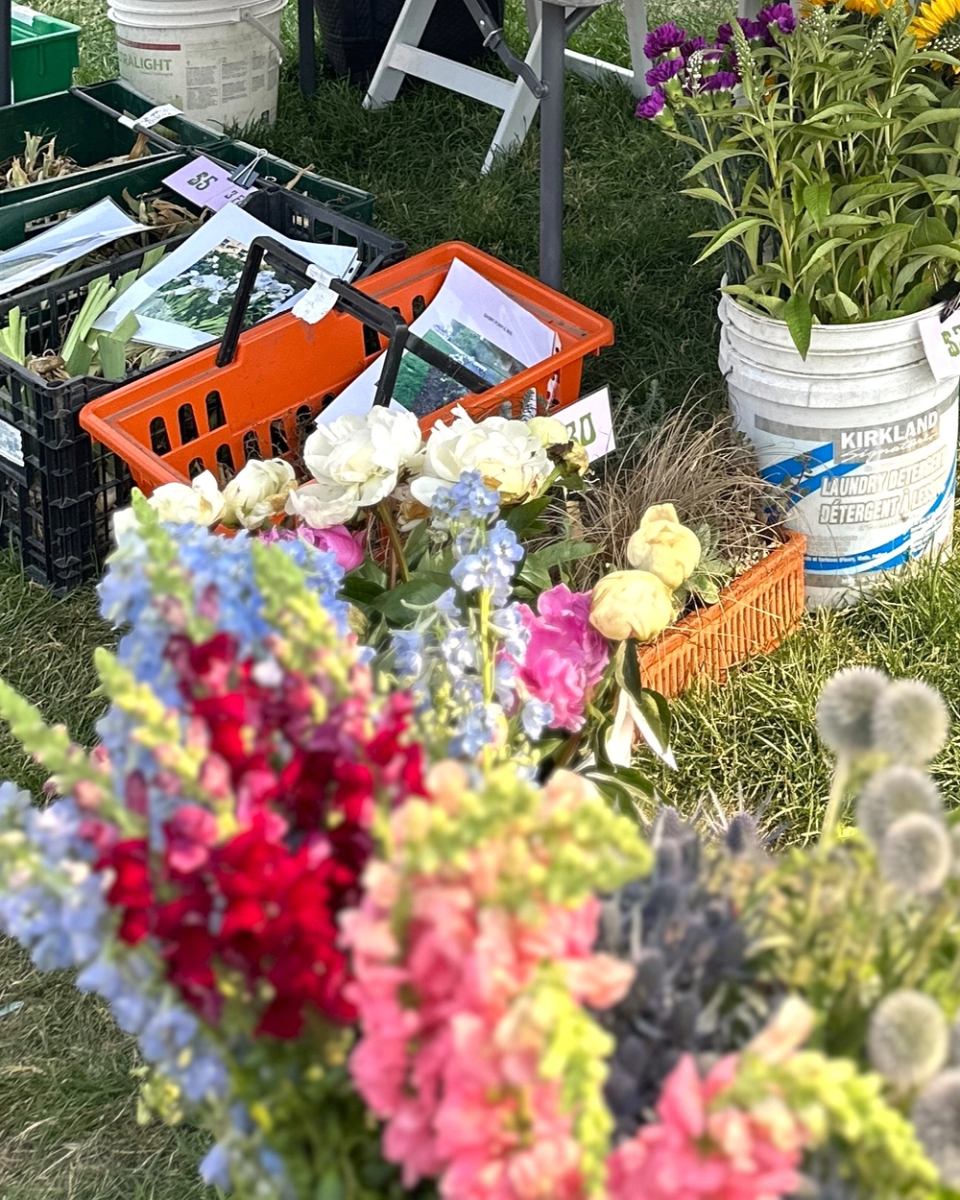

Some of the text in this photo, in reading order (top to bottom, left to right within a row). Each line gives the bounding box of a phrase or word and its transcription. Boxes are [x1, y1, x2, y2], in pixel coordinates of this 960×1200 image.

[187, 171, 219, 191] $5
[565, 412, 597, 447] 20
[841, 411, 938, 450] KIRKLAND
[821, 470, 889, 498] LAUNDRY
[818, 495, 900, 525] DÉTERGENT
